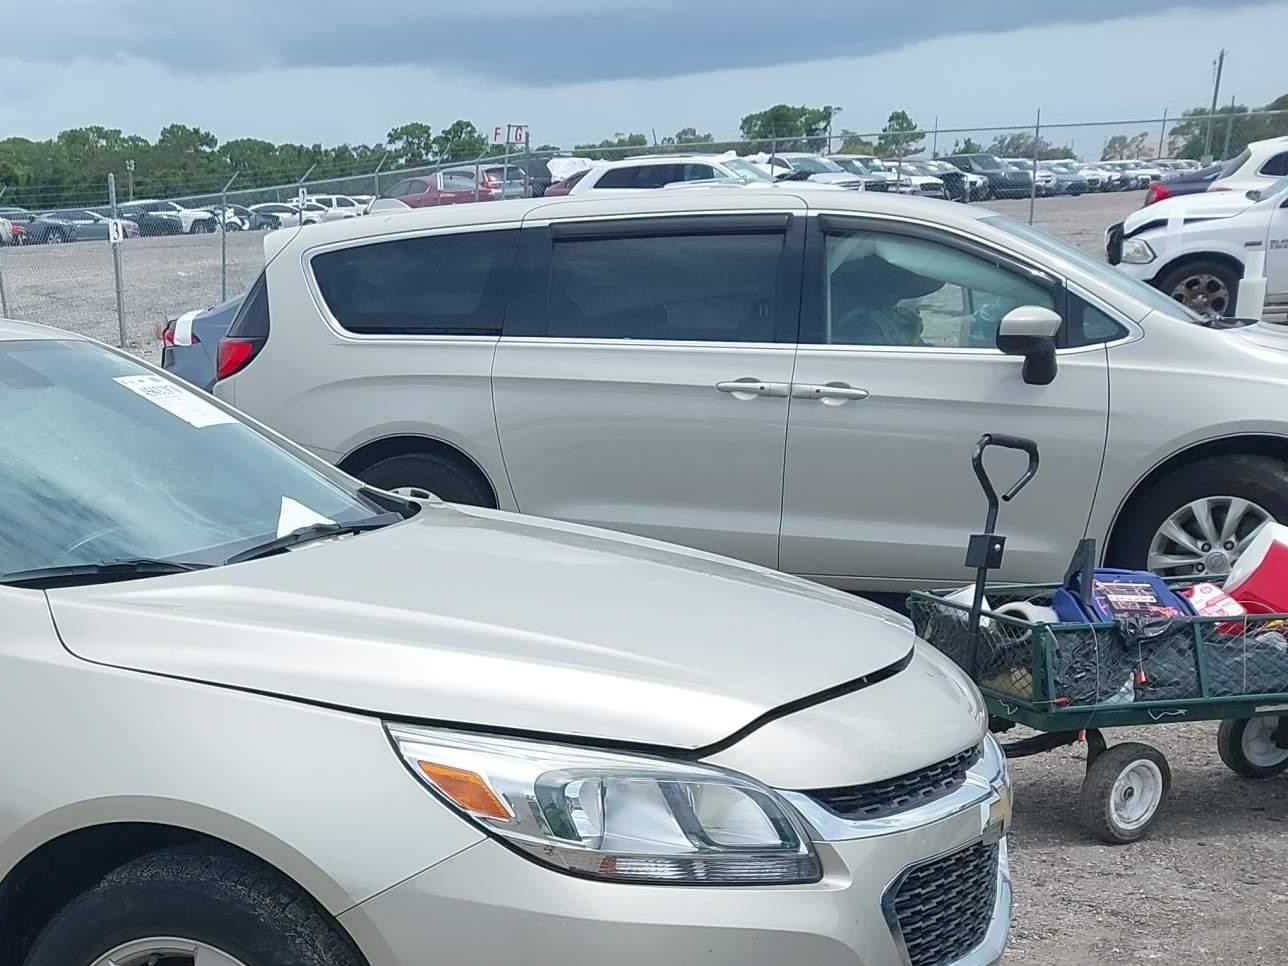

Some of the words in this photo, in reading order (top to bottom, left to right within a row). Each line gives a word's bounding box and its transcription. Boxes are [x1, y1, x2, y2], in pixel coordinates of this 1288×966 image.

[494, 127, 501, 142] F
[515, 126, 523, 142] G
[112, 221, 120, 241] 3
